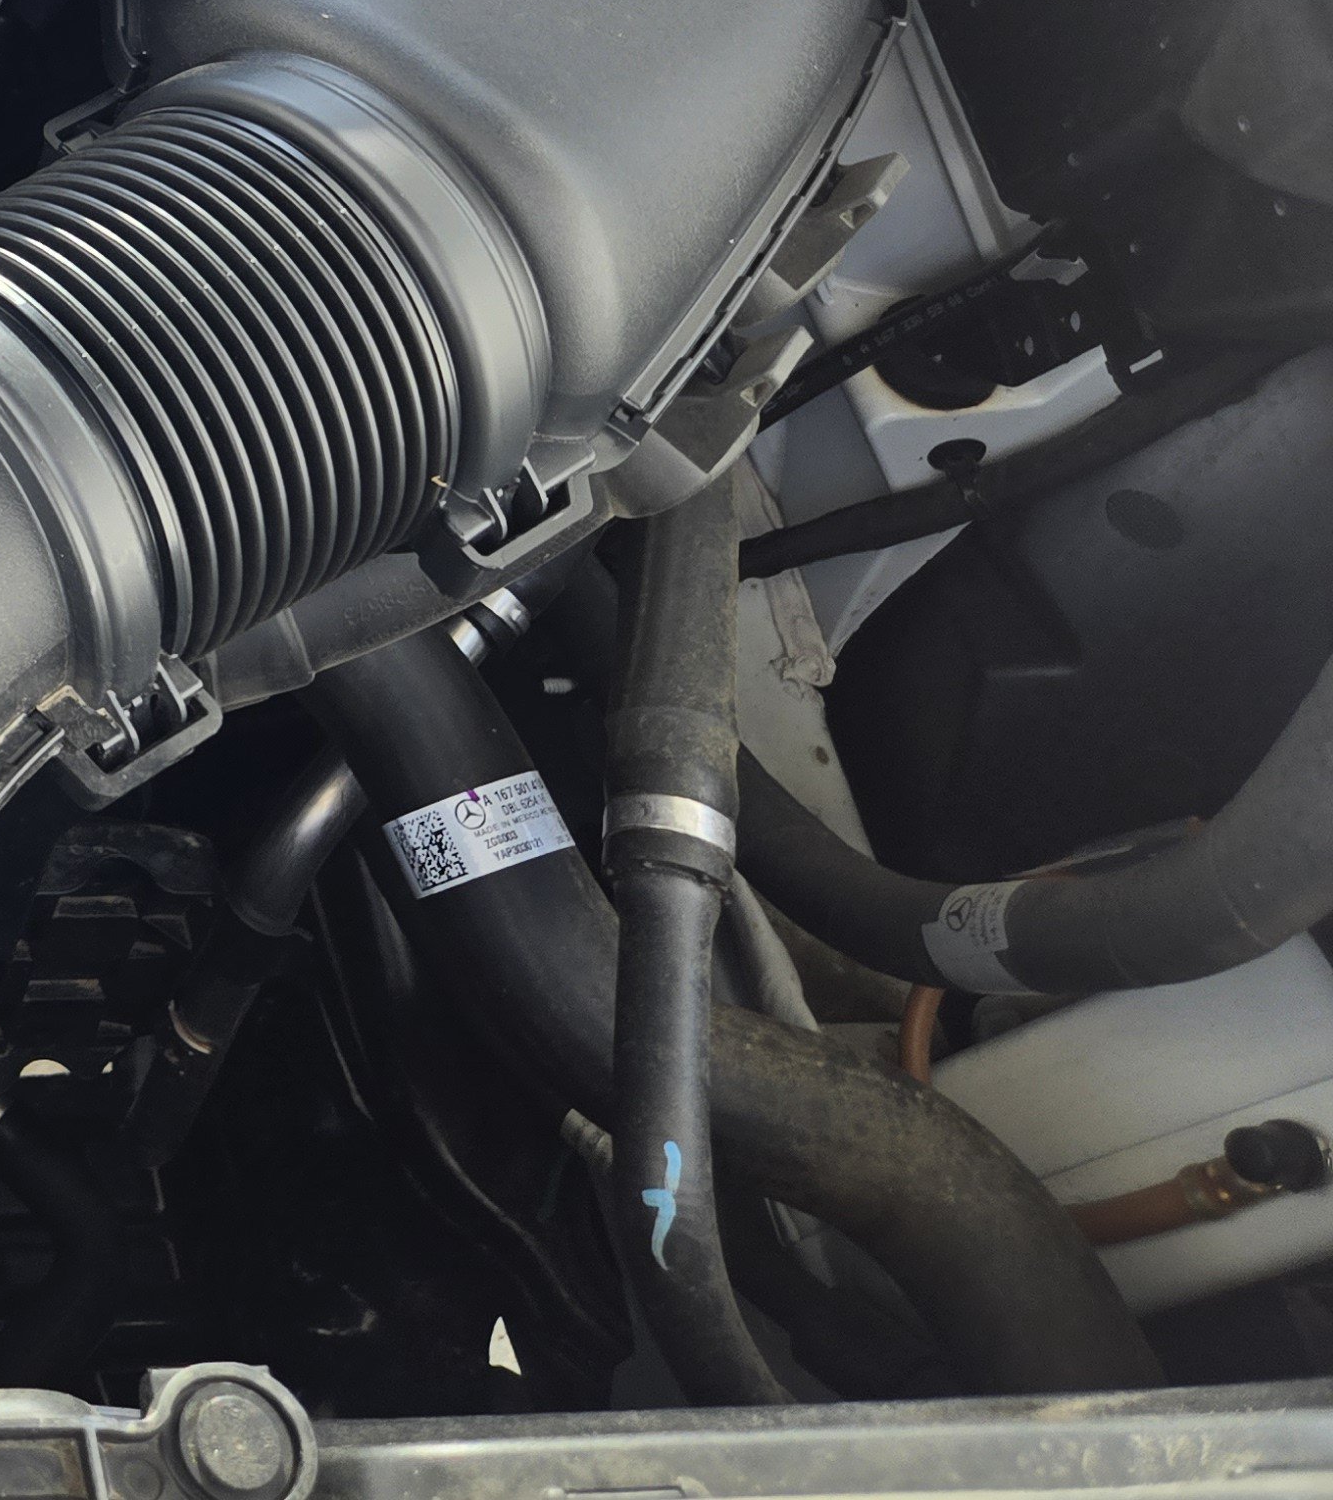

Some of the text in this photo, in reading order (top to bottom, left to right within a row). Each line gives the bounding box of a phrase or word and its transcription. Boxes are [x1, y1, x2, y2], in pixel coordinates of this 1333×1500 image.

[482, 795, 493, 808] A
[494, 786, 514, 803] 167
[501, 802, 520, 817] DBL
[474, 824, 501, 839] MADE
[501, 819, 512, 829] IN
